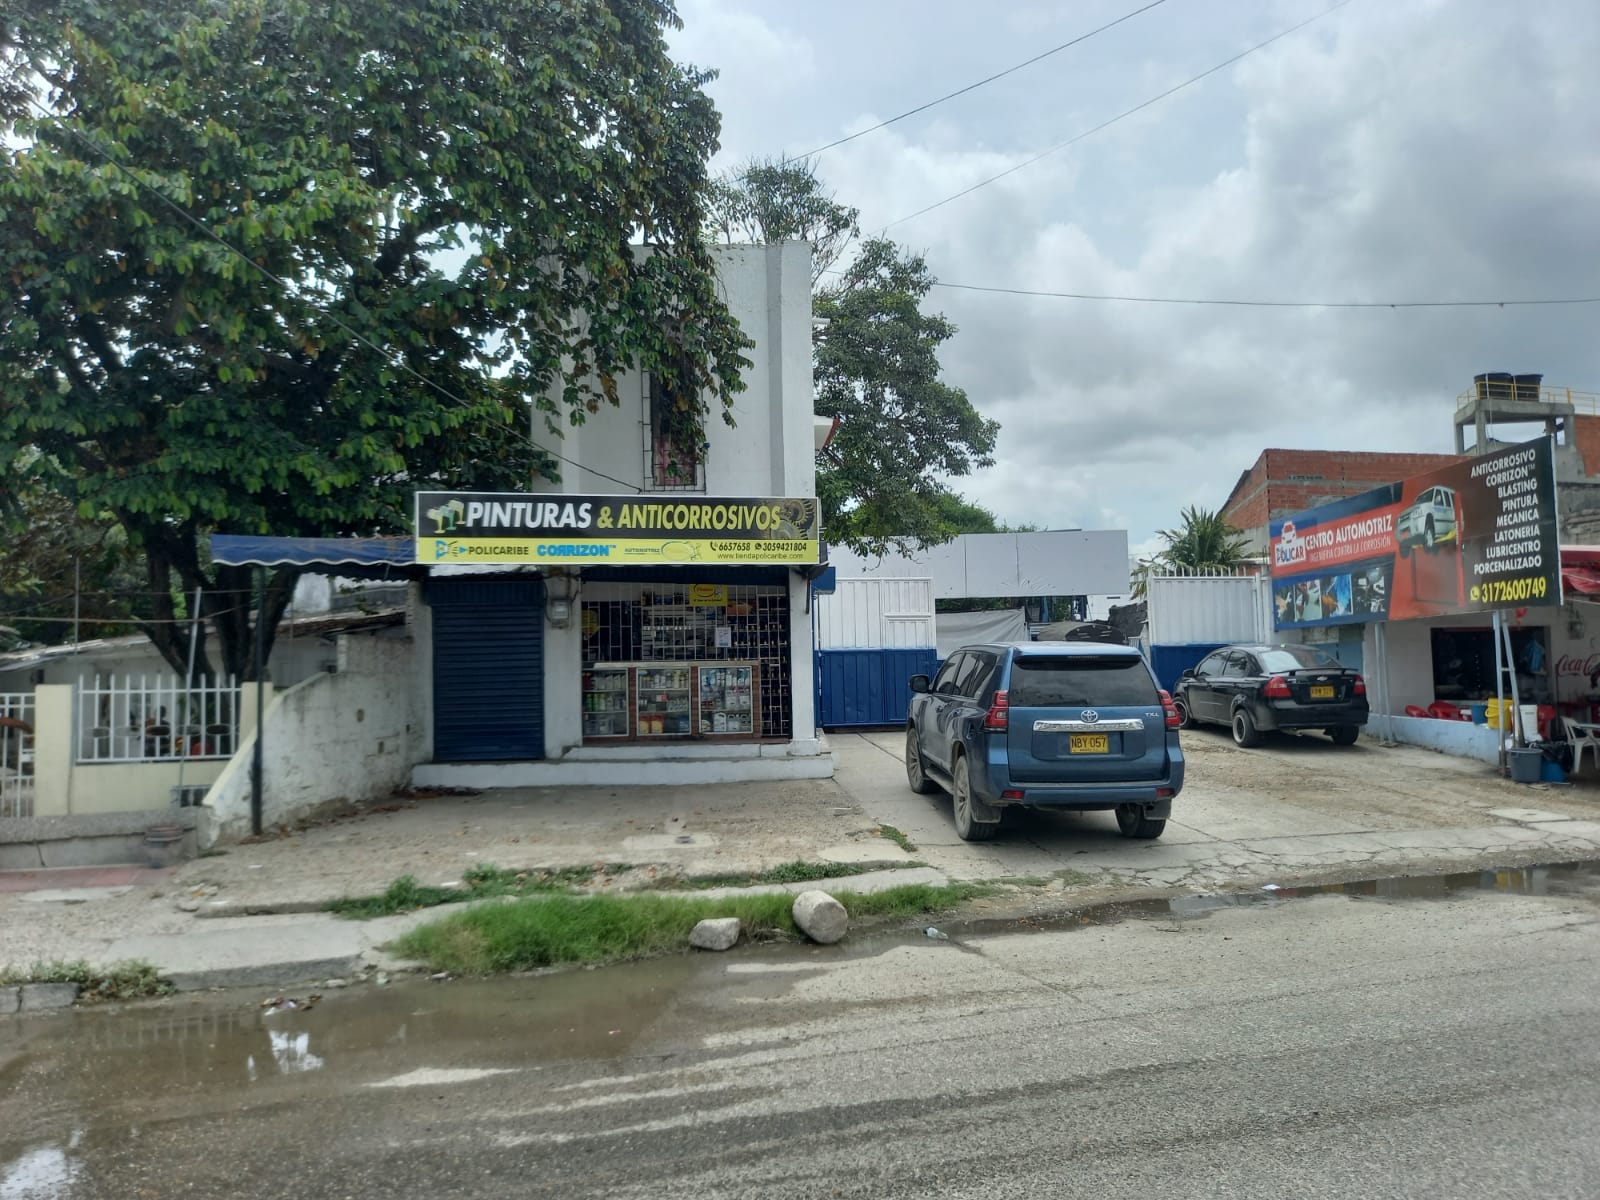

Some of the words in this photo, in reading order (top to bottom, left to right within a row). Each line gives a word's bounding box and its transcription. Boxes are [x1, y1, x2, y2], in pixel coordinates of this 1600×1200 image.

[1470, 448, 1536, 478] ANTICORROSIVO
[1497, 477, 1538, 499] BLASTING
[1502, 492, 1539, 513] PINTURA
[465, 501, 592, 529] PINTURAS
[596, 505, 614, 529] &
[617, 503, 781, 531] ANTICORROSIVOS
[1496, 508, 1540, 528] MECANICA
[1305, 529, 1334, 551] CENTRO
[1335, 514, 1392, 544] AUTOMOTRIZ
[1494, 523, 1540, 543] LATONERIA
[468, 546, 529, 555] POLICARIBE
[717, 552, 803, 561] www.tiendapolicaribe.com
[718, 542, 751, 552] 6657658
[762, 542, 807, 553] 3059421804
[1276, 545, 1304, 563] POLICAR
[1353, 543, 1360, 554] LA
[1486, 539, 1541, 560] LUBRICENTRO
[1473, 555, 1542, 576] PORCENALIZADO
[1481, 576, 1547, 604] 3172600749
[1071, 737, 1088, 748] NBY
[1089, 737, 1106, 748] 057
